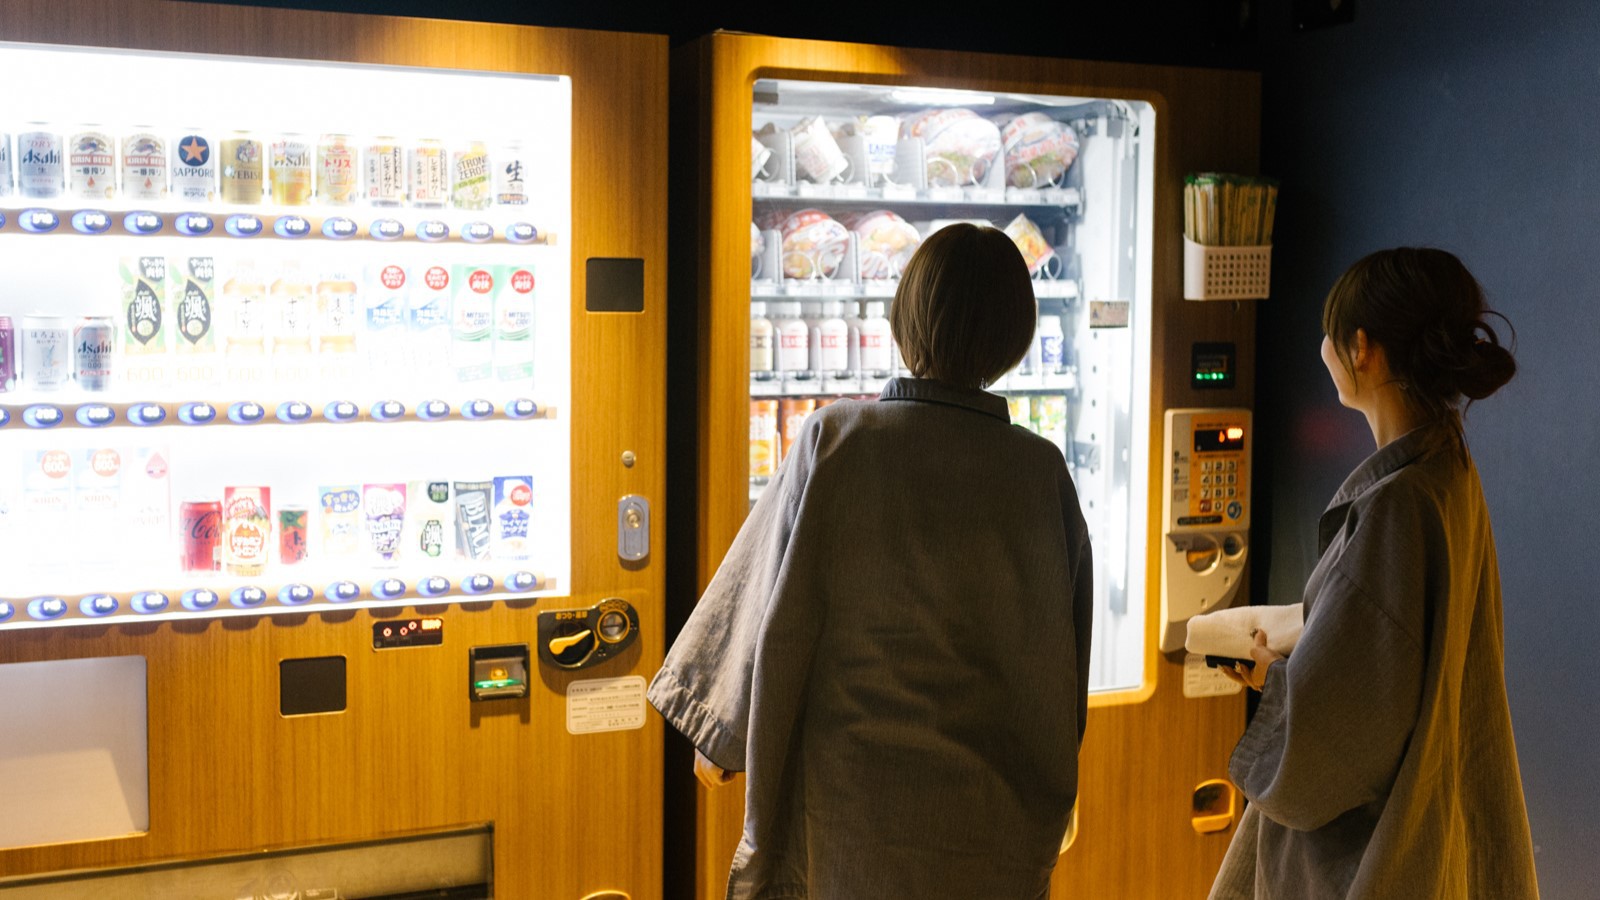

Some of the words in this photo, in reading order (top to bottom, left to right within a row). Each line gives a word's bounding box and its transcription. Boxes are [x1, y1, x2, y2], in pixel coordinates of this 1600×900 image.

[23, 147, 61, 165] Asahi
[71, 155, 91, 164] KIRIN
[92, 155, 112, 164] BEER
[127, 157, 150, 166] KIRIN
[325, 158, 351, 169] トリス
[75, 167, 107, 176] 一番搾り
[132, 167, 162, 177] 一番搾り
[173, 166, 215, 179] SAPPORO
[505, 159, 525, 184] 生
[30, 330, 65, 339] ほろよい
[77, 340, 113, 355] Asahi
